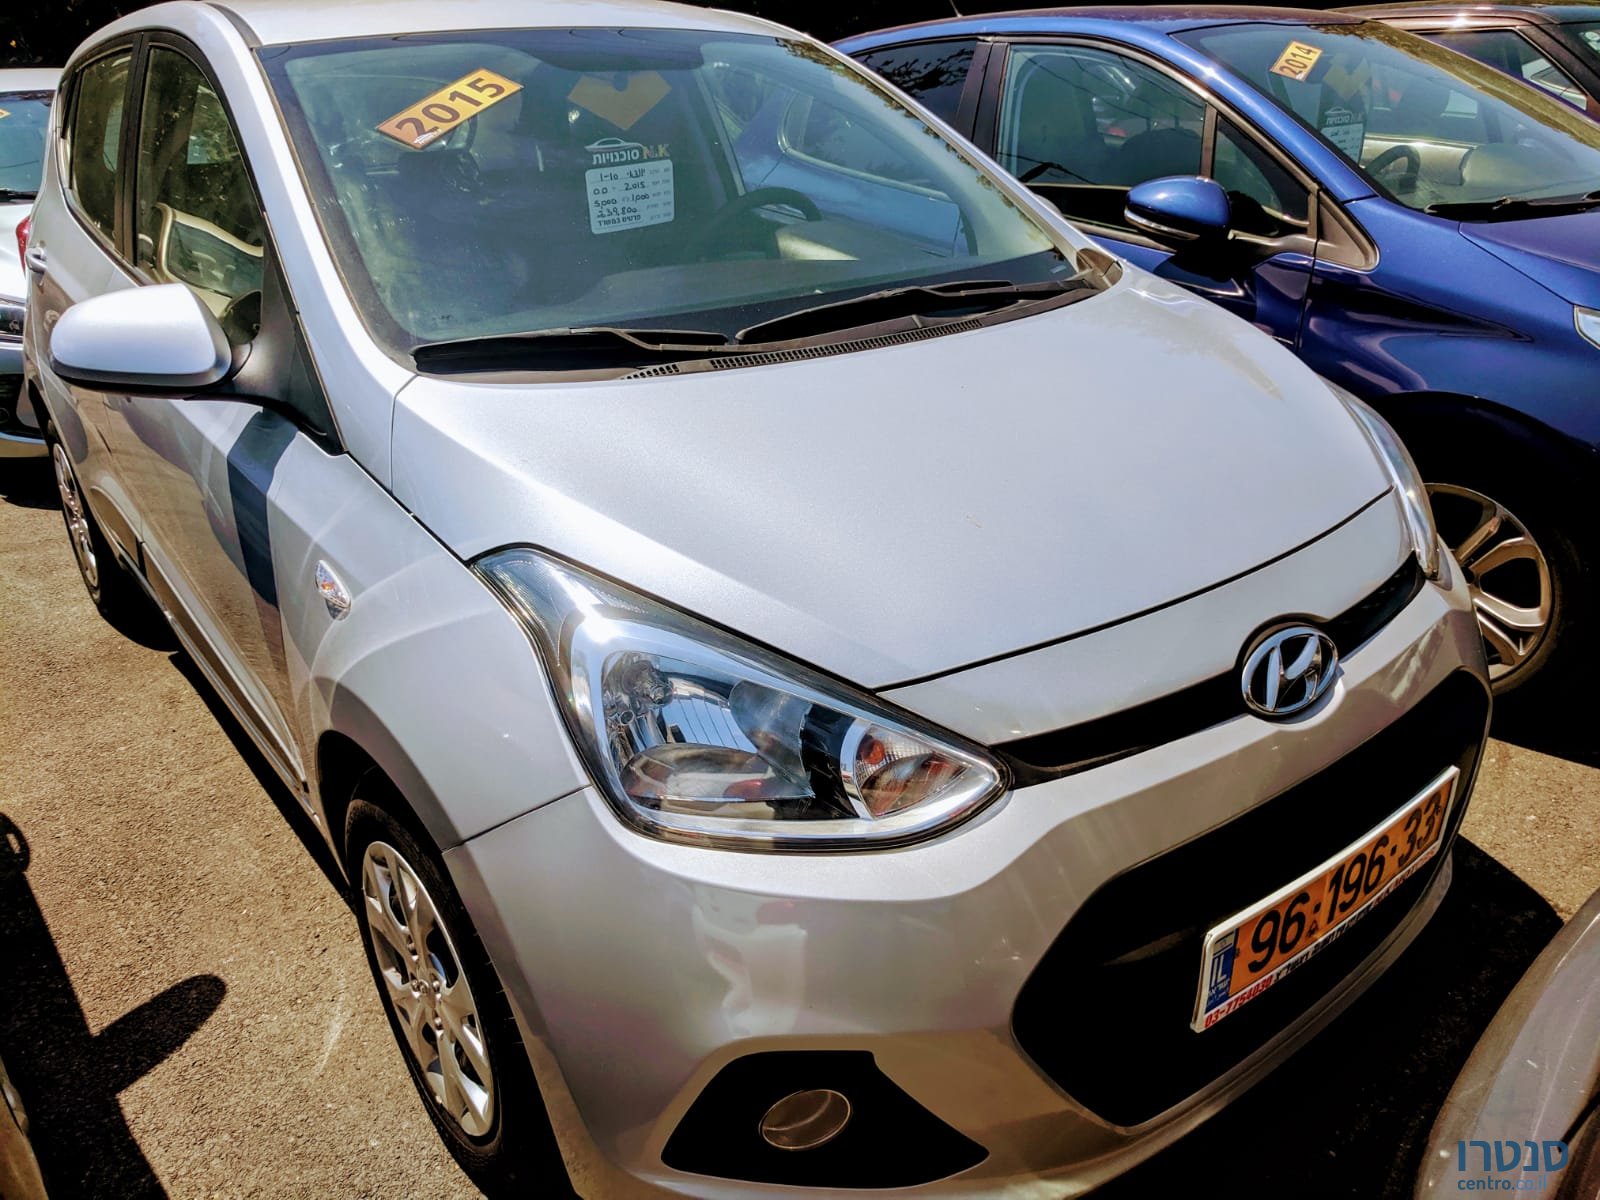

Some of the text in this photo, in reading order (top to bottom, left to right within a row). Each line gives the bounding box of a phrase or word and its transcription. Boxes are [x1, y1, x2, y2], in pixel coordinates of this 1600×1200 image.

[1279, 45, 1317, 75] 2014
[394, 76, 506, 137] 2015
[592, 149, 639, 165] סוכנויות
[624, 181, 647, 192] 2015
[1212, 954, 1227, 987] IL
